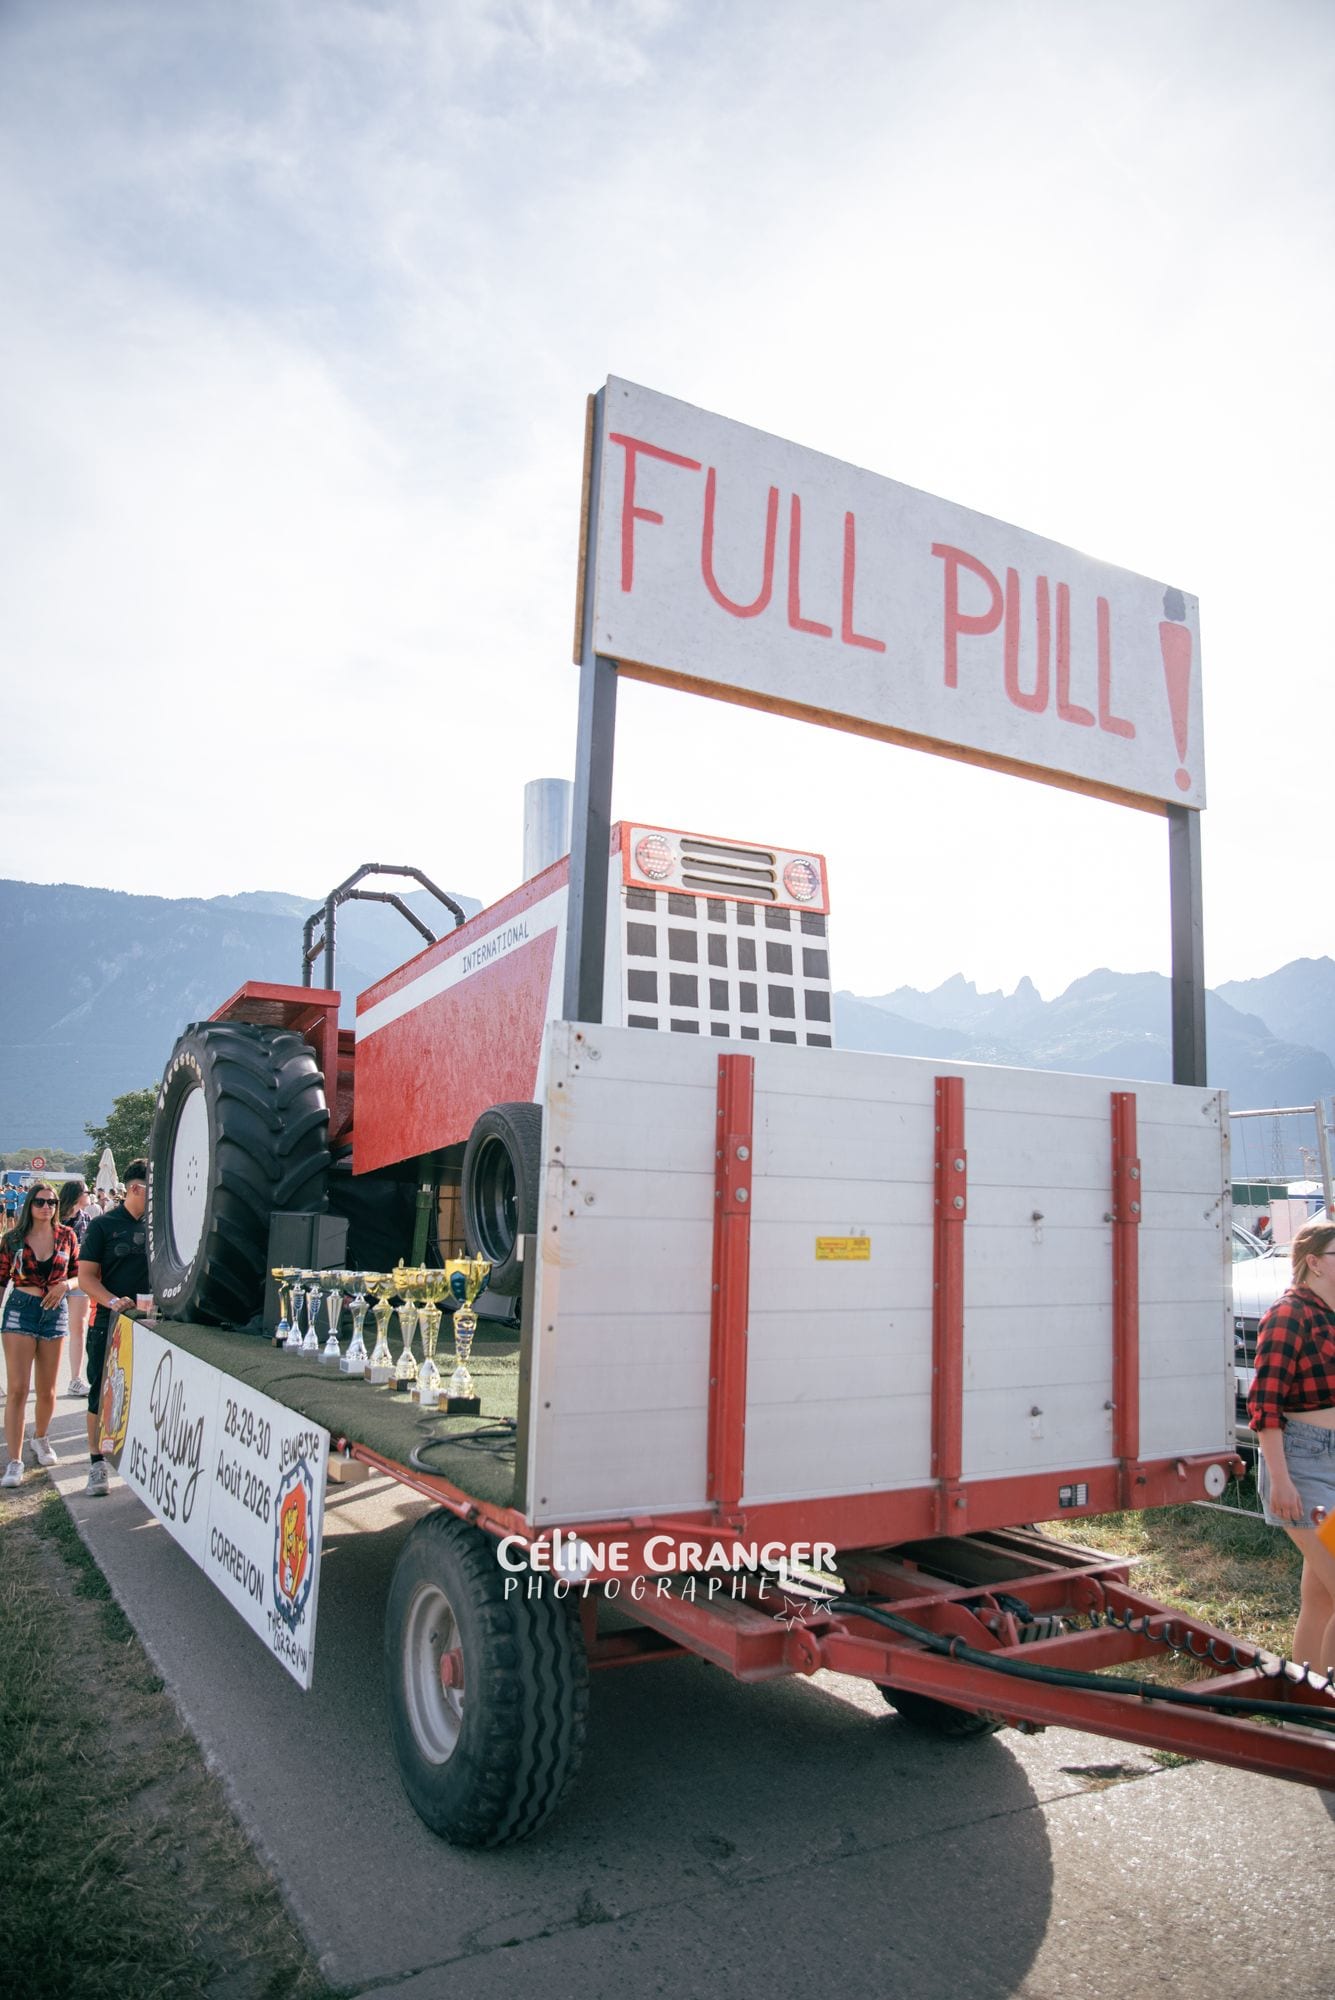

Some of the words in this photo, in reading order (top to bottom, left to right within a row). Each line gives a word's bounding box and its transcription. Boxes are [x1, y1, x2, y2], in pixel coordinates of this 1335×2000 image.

[609, 431, 887, 653] FULL
[462, 917, 530, 973] INTERNATIONAL
[149, 1349, 205, 1523] Pulling
[224, 1398, 271, 1460] 28-29-30
[129, 1436, 148, 1486] DES
[149, 1454, 178, 1521] ROSS
[216, 1448, 242, 1500] Août
[242, 1469, 271, 1524] 2026
[211, 1526, 264, 1606] CORREVON
